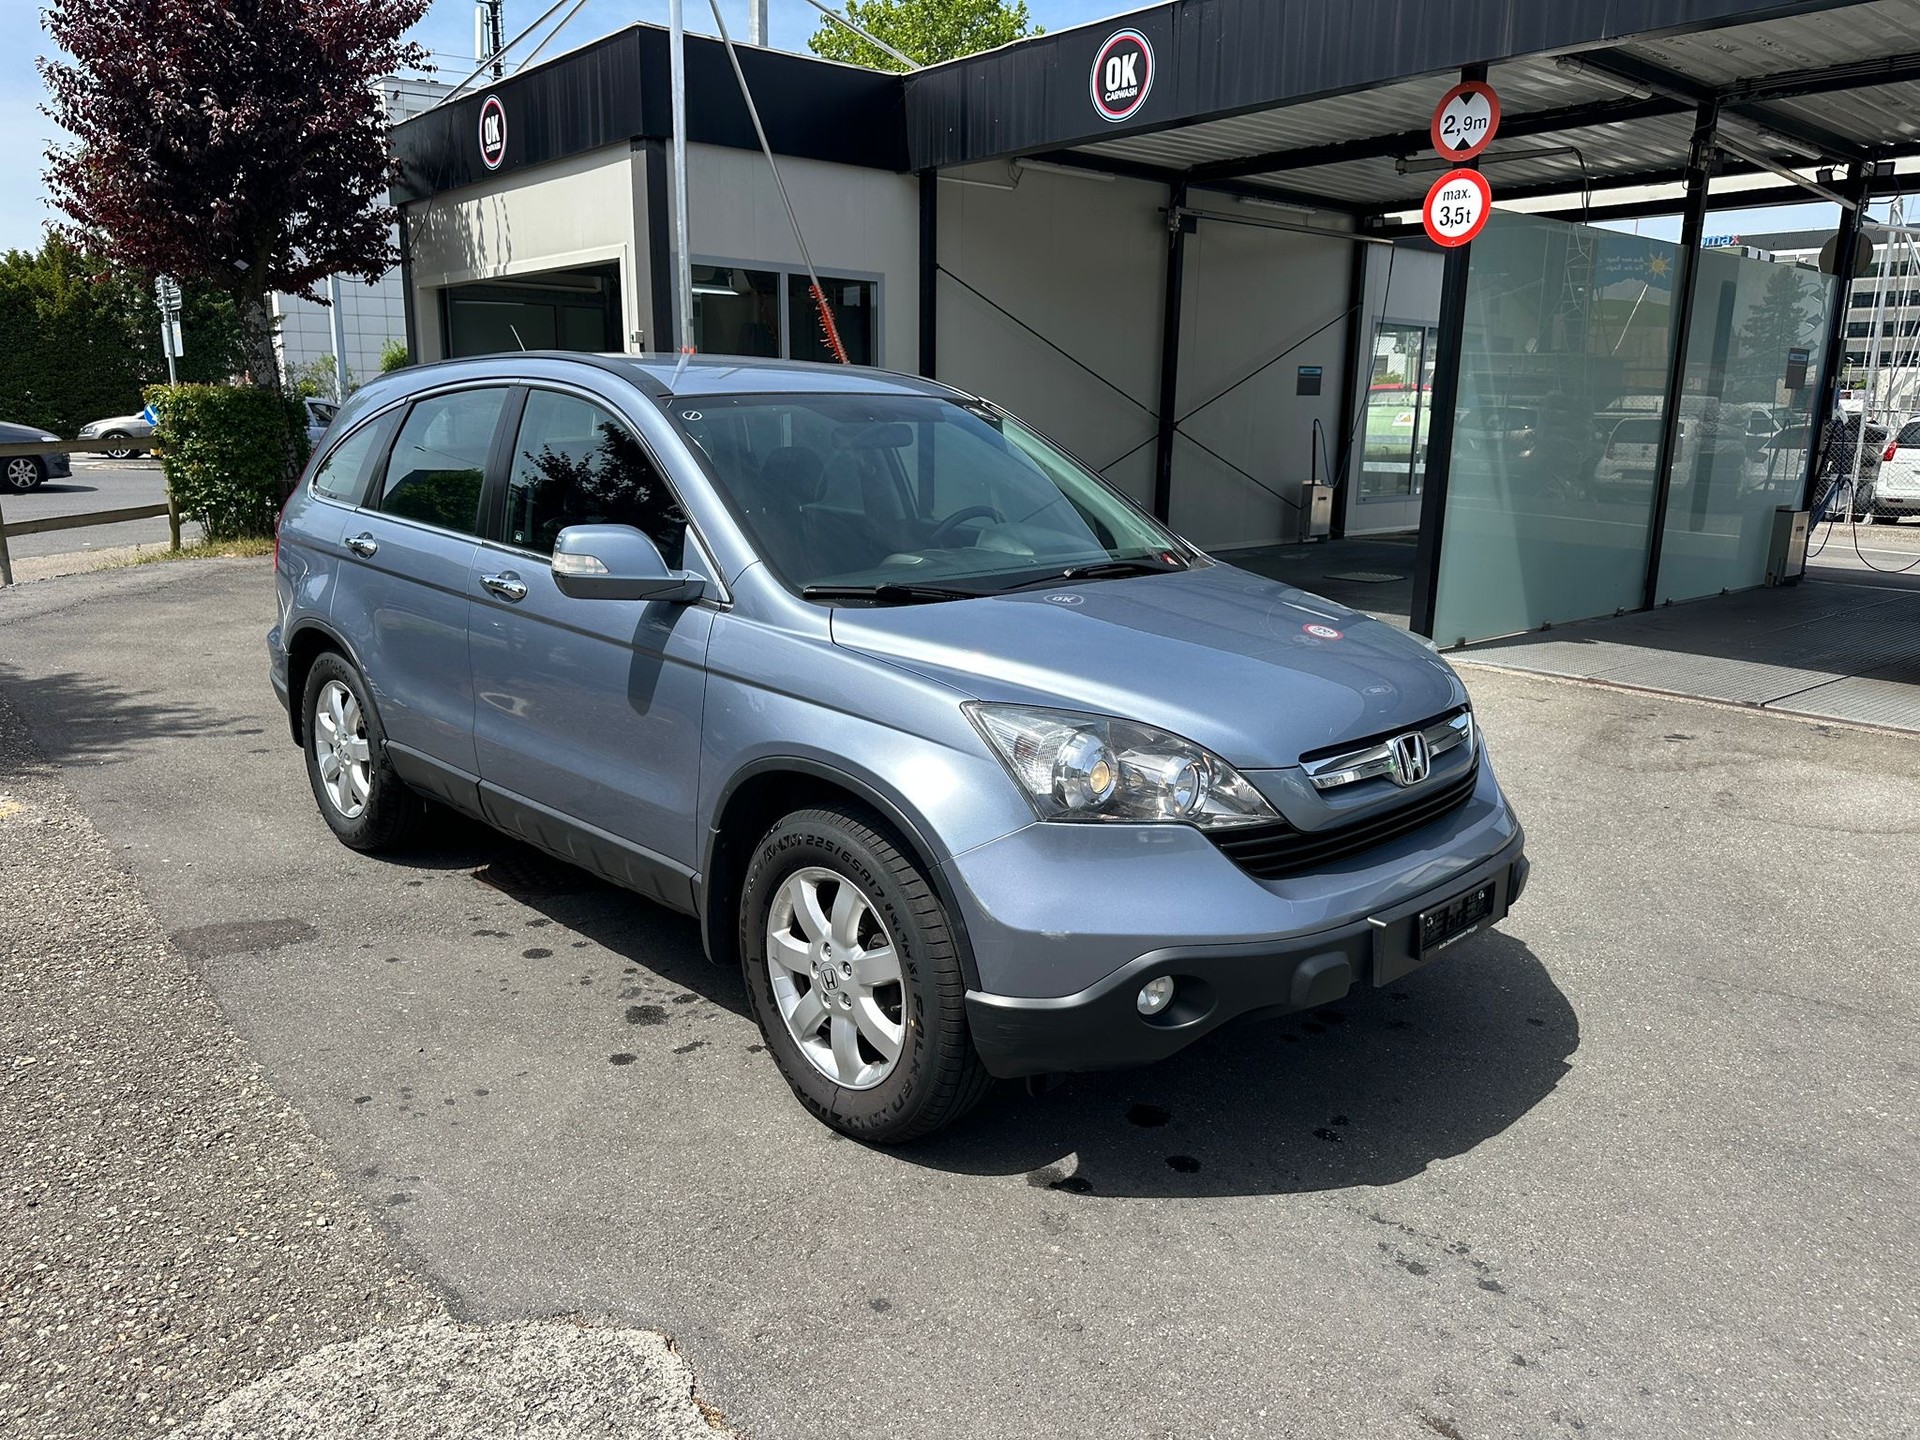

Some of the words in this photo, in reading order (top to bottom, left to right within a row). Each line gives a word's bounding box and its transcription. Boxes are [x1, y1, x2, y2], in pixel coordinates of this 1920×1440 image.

[1105, 52, 1138, 92] OK
[1104, 86, 1138, 102] CARWASH
[485, 114, 500, 145] OK
[1443, 115, 1488, 136] 2,9m
[1442, 188, 1471, 201] max.
